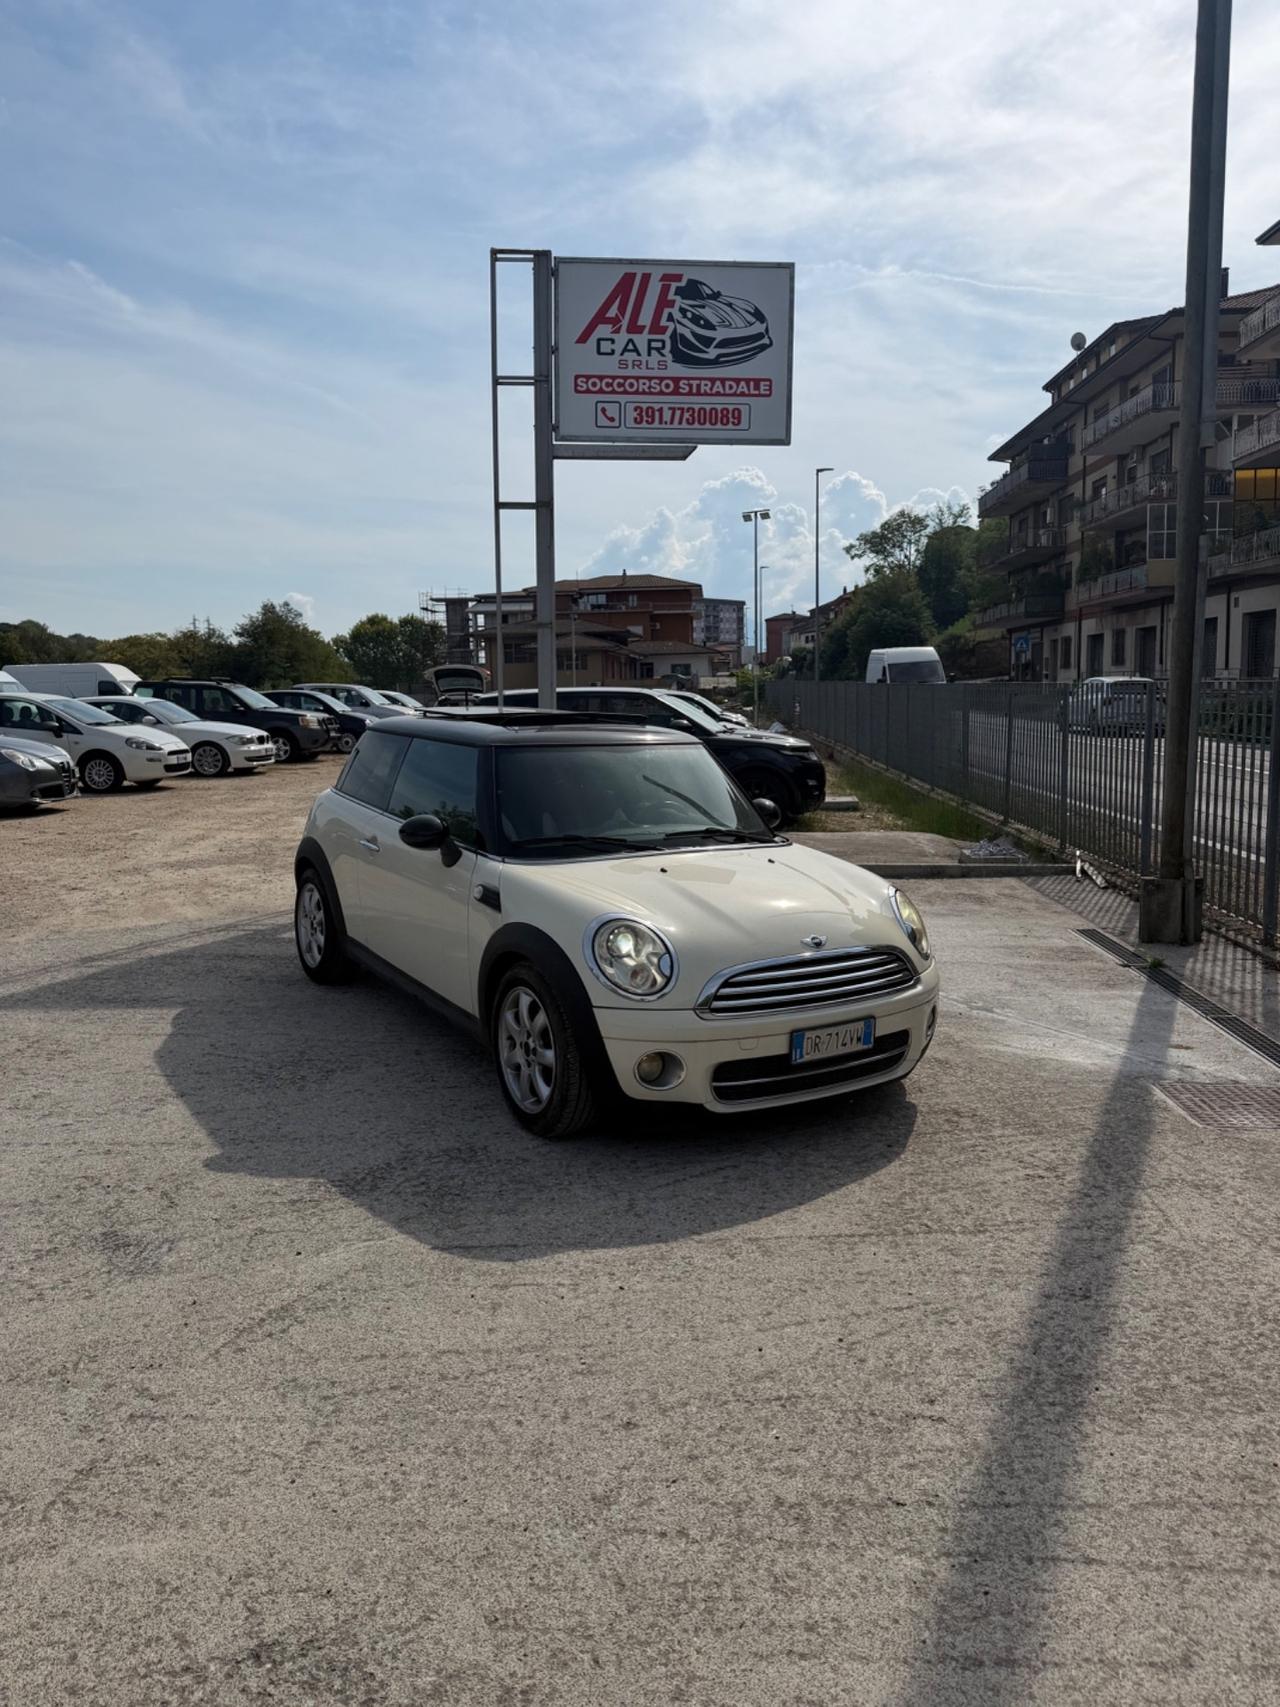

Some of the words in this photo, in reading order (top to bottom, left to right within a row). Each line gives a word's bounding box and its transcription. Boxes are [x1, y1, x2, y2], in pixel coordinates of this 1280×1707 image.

[575, 272, 683, 344] ALE
[597, 338, 667, 356] CAR
[618, 360, 668, 370] SRLS
[577, 378, 674, 392] SOCCORSO
[679, 380, 770, 395] STRADALE
[633, 405, 742, 426] 391.7730089
